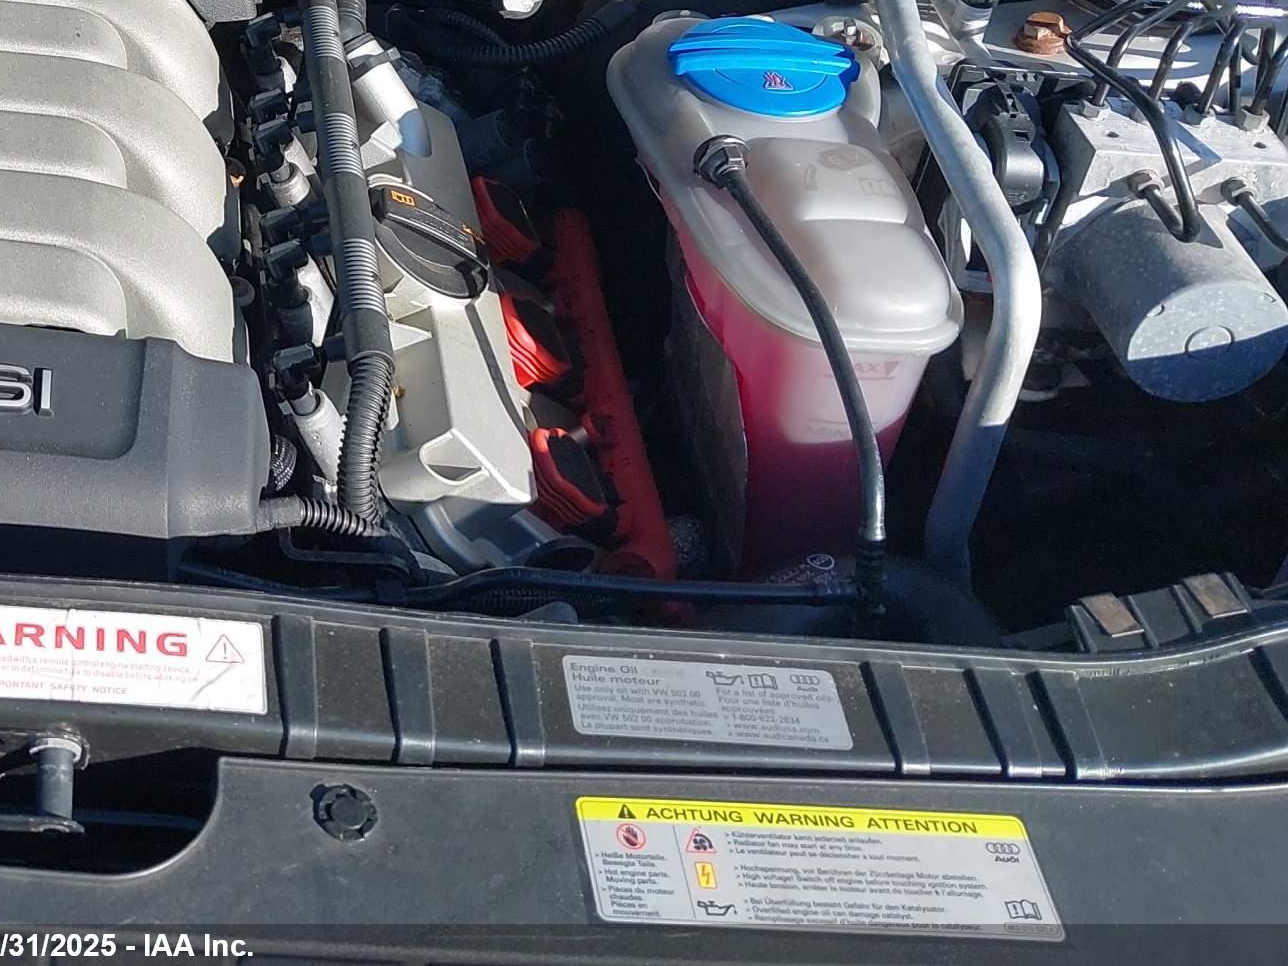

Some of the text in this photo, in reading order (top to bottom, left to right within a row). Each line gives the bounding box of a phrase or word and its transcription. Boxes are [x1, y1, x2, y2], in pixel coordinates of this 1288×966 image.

[570, 662, 638, 675] Engine Oil
[571, 672, 661, 685] Huile moteur
[50, 682, 87, 693] SAFETY
[92, 686, 129, 695] NOTICE
[574, 684, 592, 692] Use
[594, 686, 614, 695] only
[630, 687, 650, 695] with
[652, 688, 668, 696] VW
[671, 689, 687, 697] 502
[689, 690, 701, 698] 00
[716, 687, 732, 695] For
[742, 689, 755, 697] list
[758, 690, 767, 698] of
[770, 691, 812, 701] approved
[621, 694, 644, 703] Most
[718, 696, 740, 704] Pour
[762, 698, 781, 707] liste
[613, 706, 669, 715] uniquement
[603, 713, 620, 721] VW
[594, 722, 628, 731] plupart
[630, 723, 650, 731] sont
[646, 807, 978, 834] ACHTUNG WARNING ATTENTION
[743, 873, 761, 881] High
